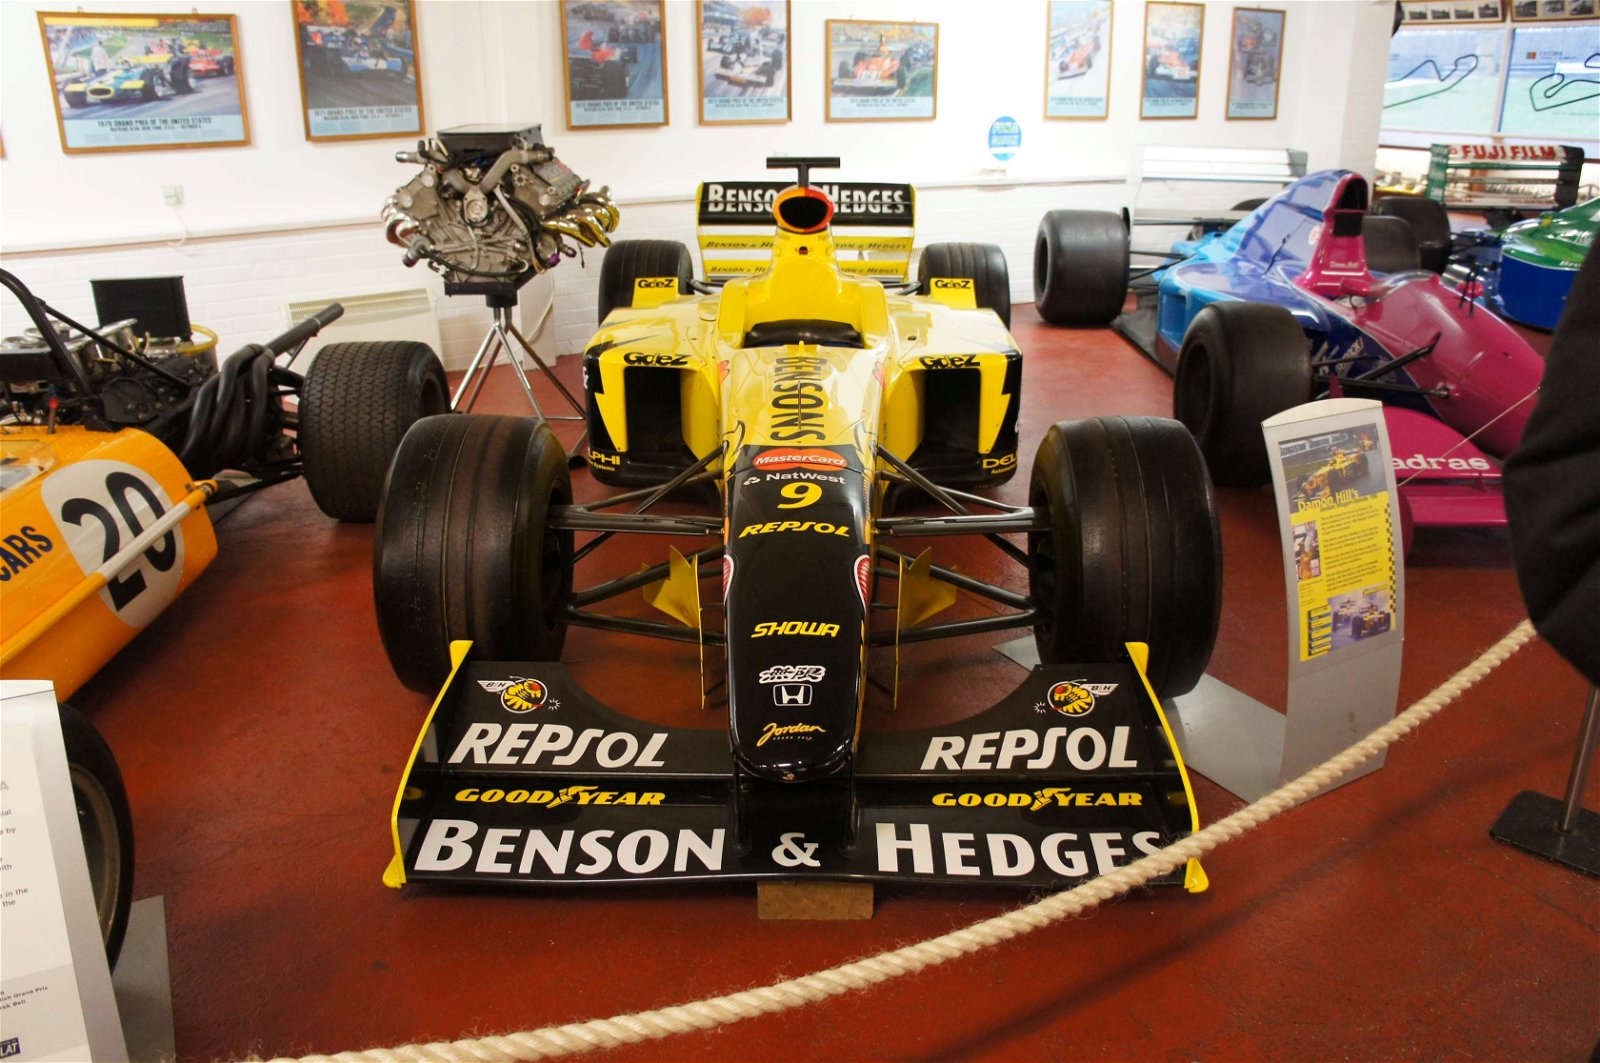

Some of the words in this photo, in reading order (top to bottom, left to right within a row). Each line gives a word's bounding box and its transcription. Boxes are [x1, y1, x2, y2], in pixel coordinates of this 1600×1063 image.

[755, 453, 846, 466] MasterCard
[766, 471, 847, 485] NatWest
[777, 482, 823, 509] 9
[1298, 494, 1336, 512] Damon
[61, 471, 177, 613] 20
[738, 521, 851, 539] REPSOL
[750, 620, 841, 638] SHOWA
[447, 722, 669, 768] REPSOL
[756, 722, 827, 747] Jordan
[919, 725, 1138, 771] REPSOL
[413, 818, 726, 875] BENSON
[771, 831, 822, 867] &
